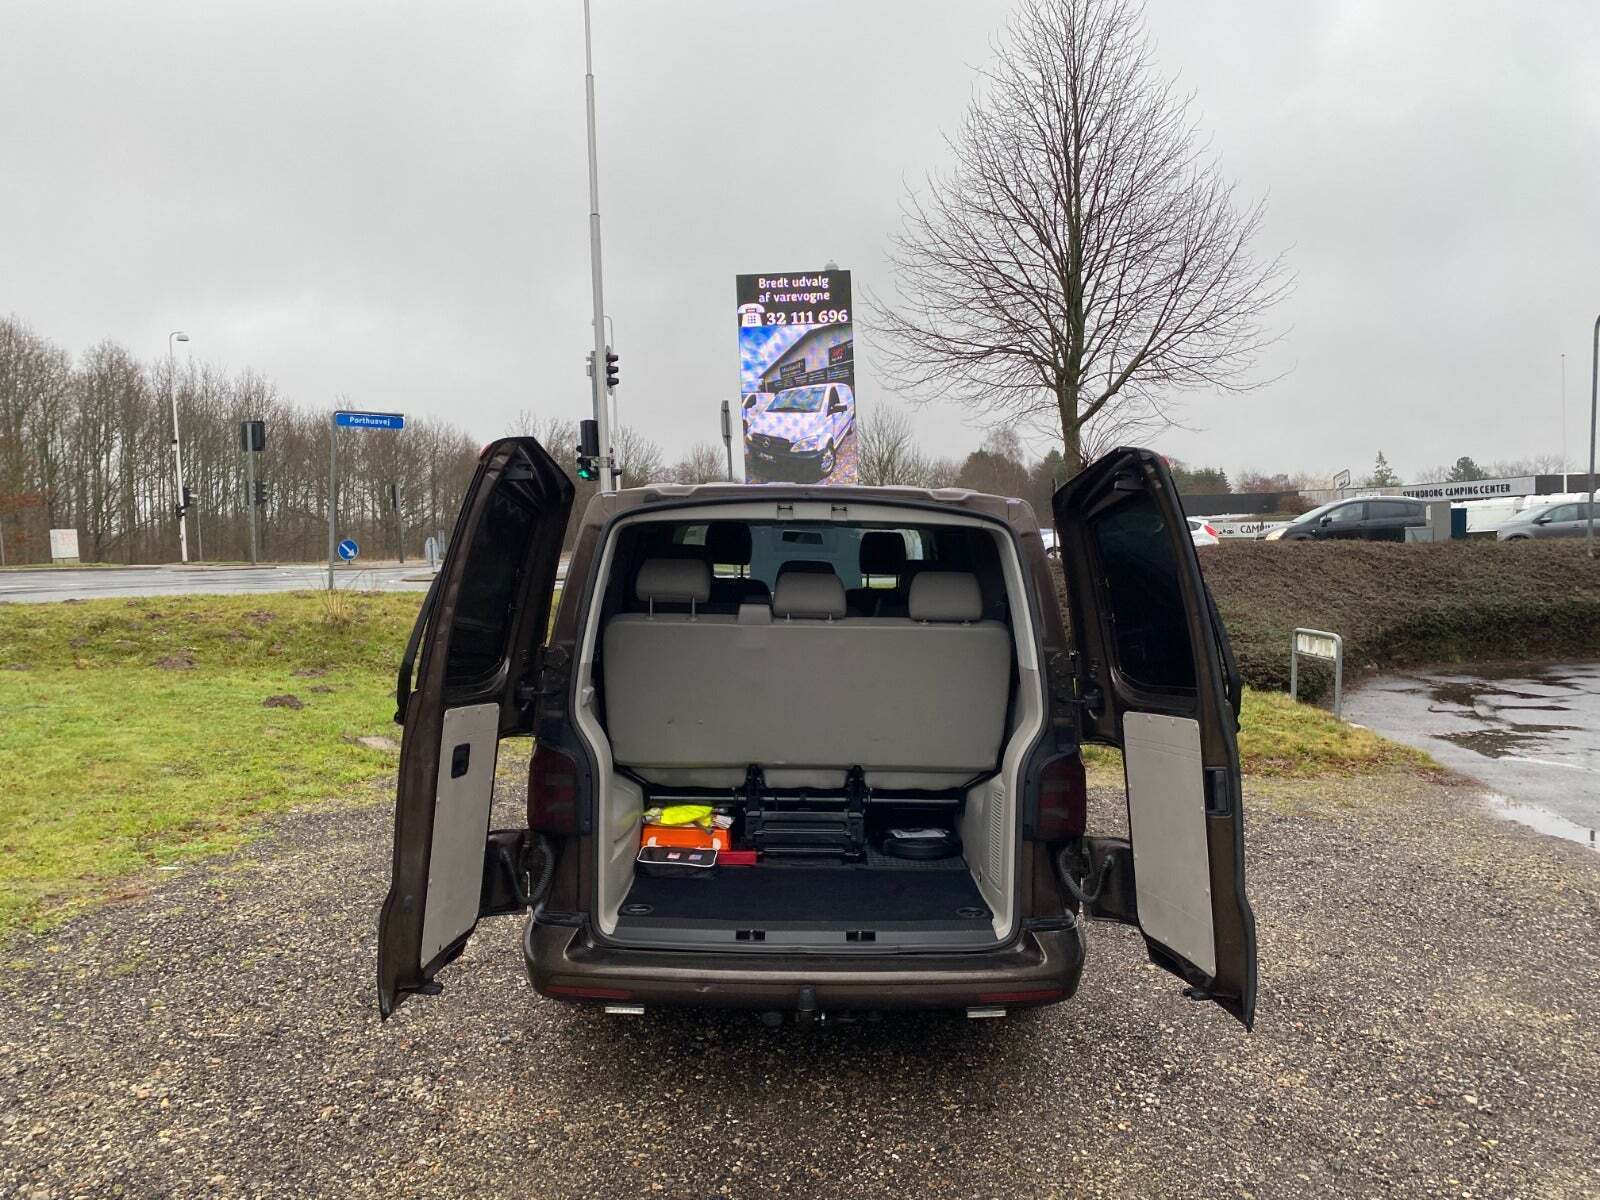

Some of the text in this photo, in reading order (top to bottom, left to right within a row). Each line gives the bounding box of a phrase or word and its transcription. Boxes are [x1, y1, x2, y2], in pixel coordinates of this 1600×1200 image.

[758, 275, 829, 289] Bredt udvalg
[758, 291, 830, 304] af varevogne
[766, 309, 849, 325] 32 111 696
[1445, 486, 1478, 496] CAMPING
[1479, 483, 1511, 494] CENTER
